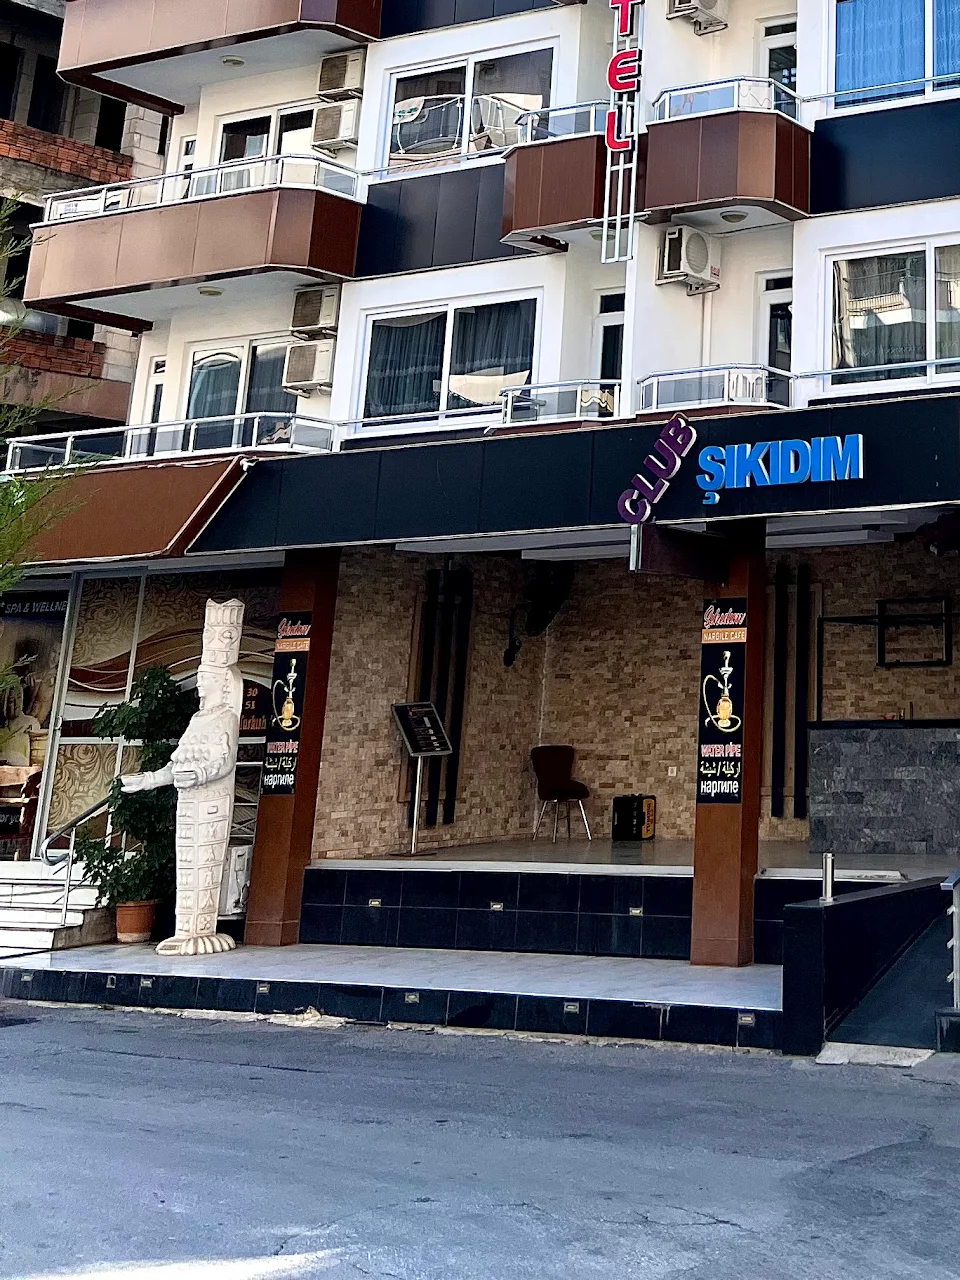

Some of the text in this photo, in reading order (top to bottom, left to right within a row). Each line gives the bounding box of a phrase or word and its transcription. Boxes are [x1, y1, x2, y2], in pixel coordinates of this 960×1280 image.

[617, 417, 864, 523] CLUB ŞIKIDIM
[5, 602, 22, 614] SPA
[701, 743, 725, 758] WATER
[700, 780, 739, 797] наргиле
